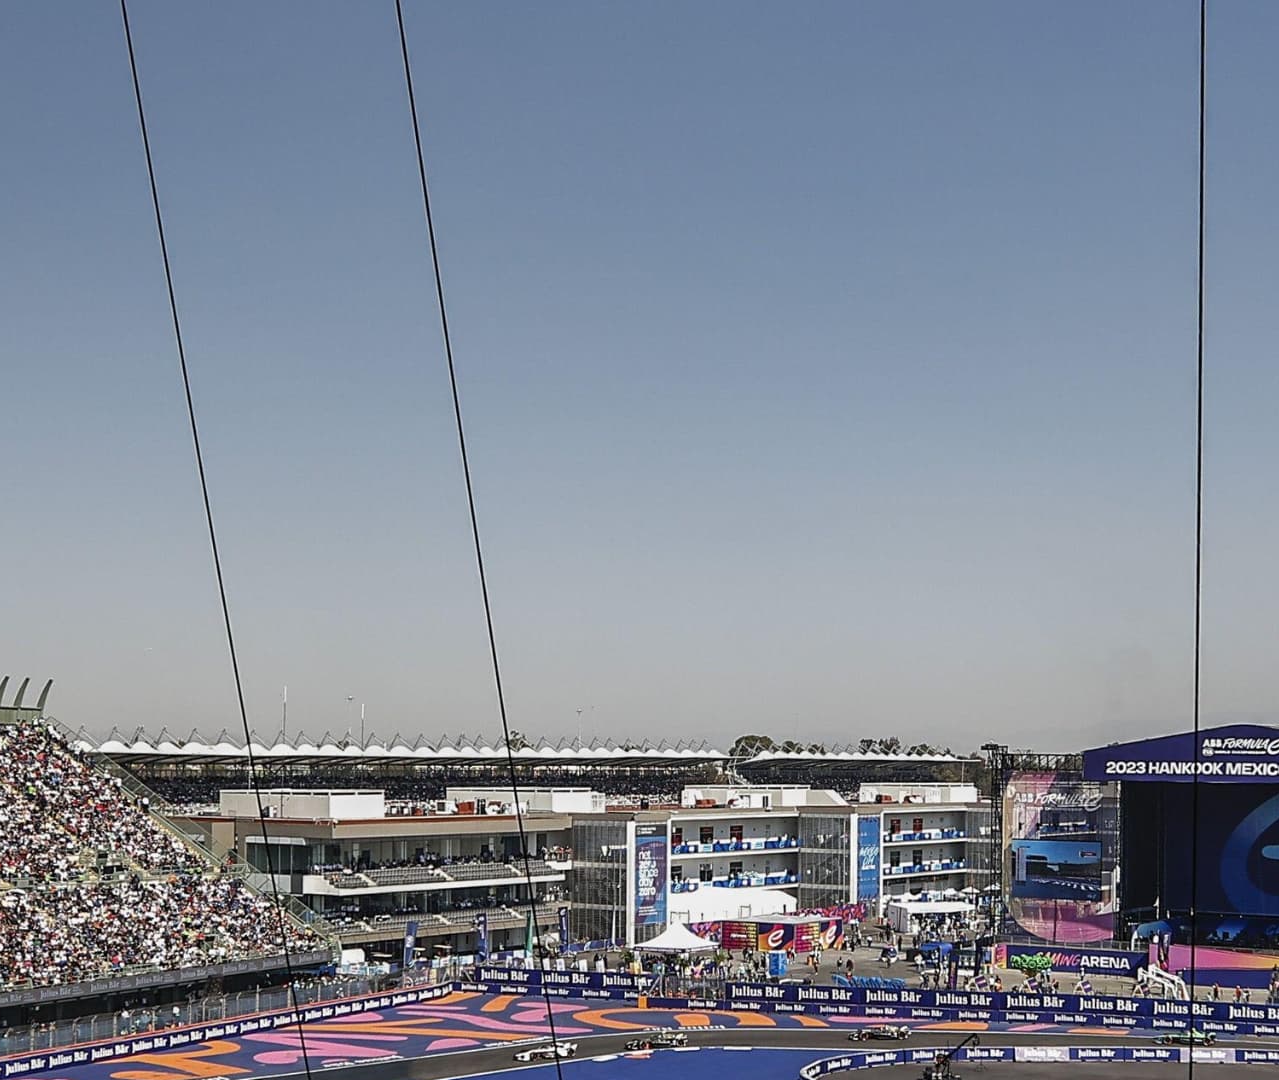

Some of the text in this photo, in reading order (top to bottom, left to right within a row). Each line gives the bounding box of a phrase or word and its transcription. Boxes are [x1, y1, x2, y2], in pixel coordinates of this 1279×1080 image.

[1203, 739, 1221, 747] ABB
[1105, 761, 1146, 775] 2023
[1148, 762, 1222, 776] HANKOOK
[480, 969, 530, 980] Julius Bär
[731, 986, 785, 997] Julius Bär
[797, 988, 853, 1000] Julius Bär
[865, 990, 922, 1002] Julius Bär
[935, 993, 992, 1005] Julius Bär
[1006, 995, 1065, 1008] Julius Bär
[1079, 998, 1139, 1011] Julius Bär
[1152, 1000, 1215, 1015] Julius Bär
[1228, 1004, 1266, 1018] Julius
[205, 1025, 238, 1039] Julius Bär
[239, 1019, 272, 1033] Julius Bär
[131, 1035, 167, 1053] Julius Bär
[170, 1031, 204, 1046] Julius Bär
[91, 1041, 129, 1060] Julius Bär
[49, 1052, 89, 1067] Julius Bär
[5, 1059, 46, 1076] Julius Bär
